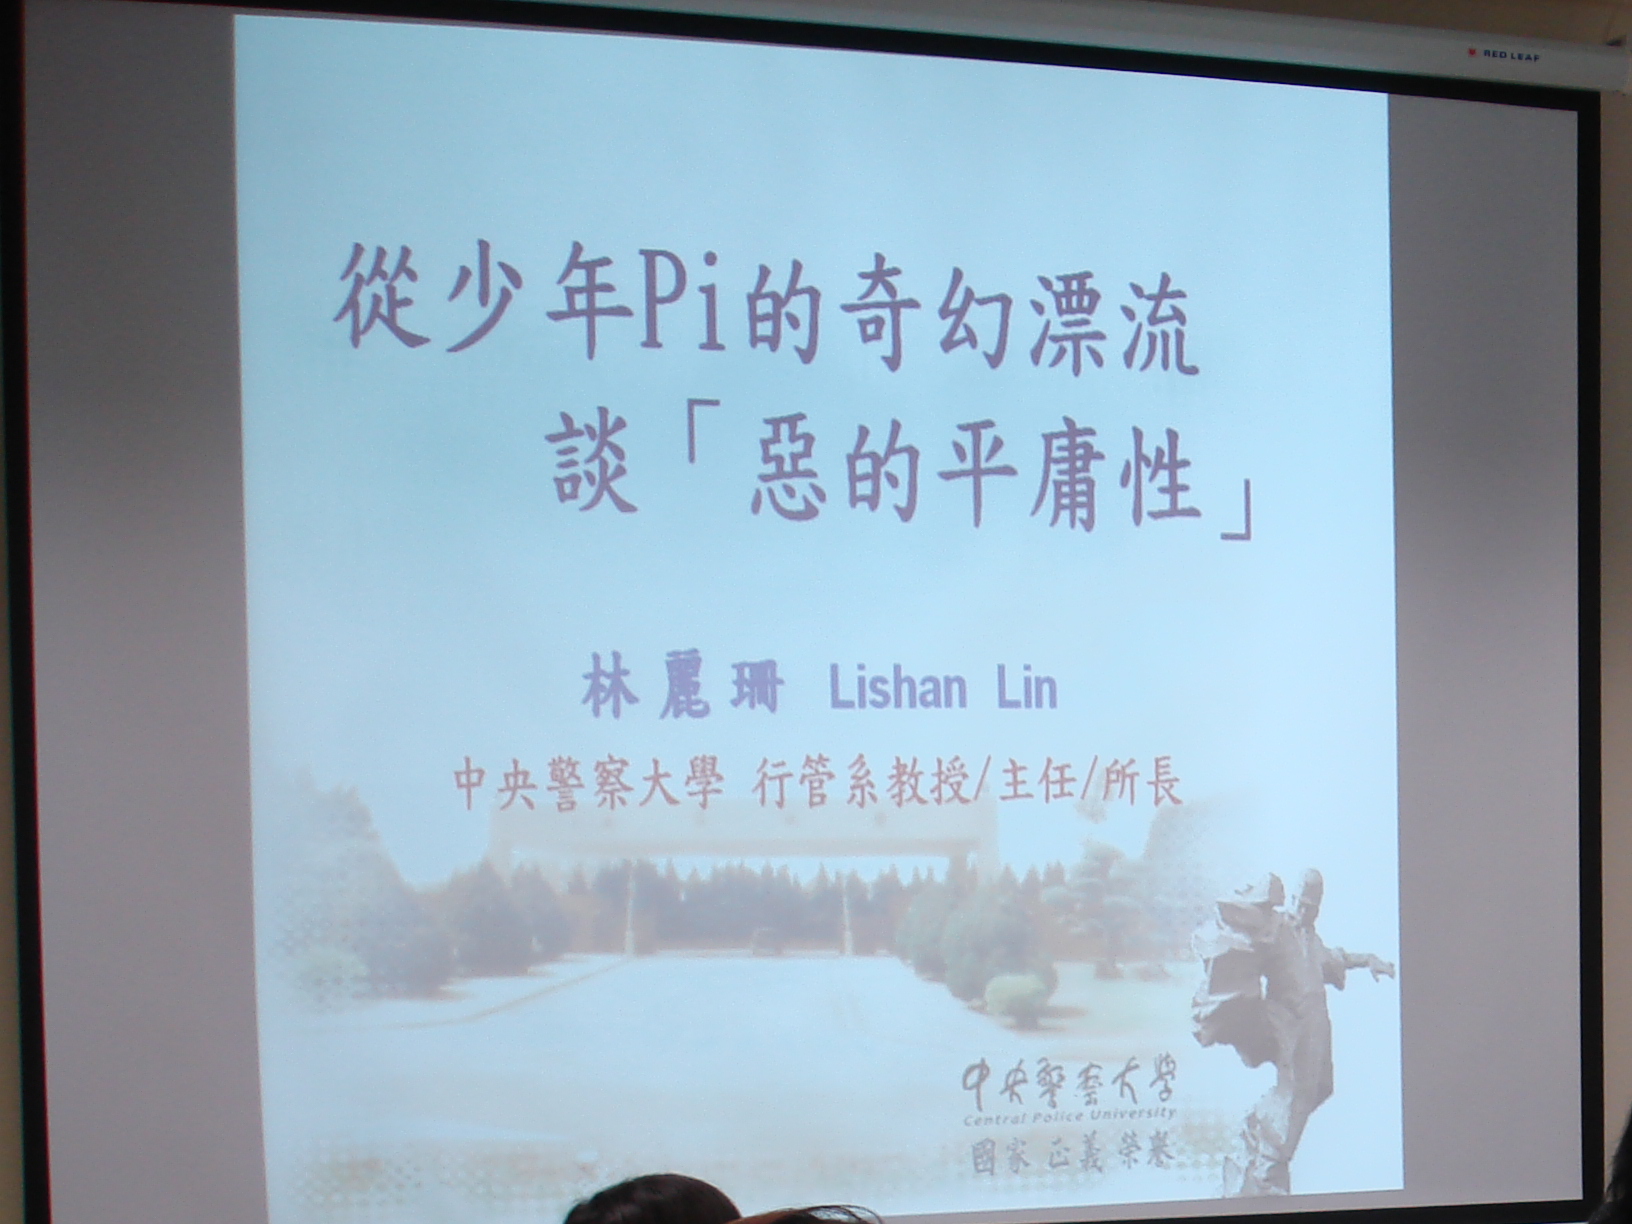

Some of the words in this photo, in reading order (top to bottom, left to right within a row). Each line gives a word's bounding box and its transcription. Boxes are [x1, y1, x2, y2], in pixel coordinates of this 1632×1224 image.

[1483, 49, 1507, 58] RED
[1510, 53, 1540, 62] LEAF
[332, 237, 1200, 378] 從少年Pi的奇幻漂流
[829, 663, 967, 709] Lishan
[996, 663, 1057, 709] Lin
[454, 753, 725, 812] 中央警察大學
[964, 1112, 1027, 1127] Central
[1032, 1110, 1084, 1124] Police
[1091, 1106, 1178, 1121] University
